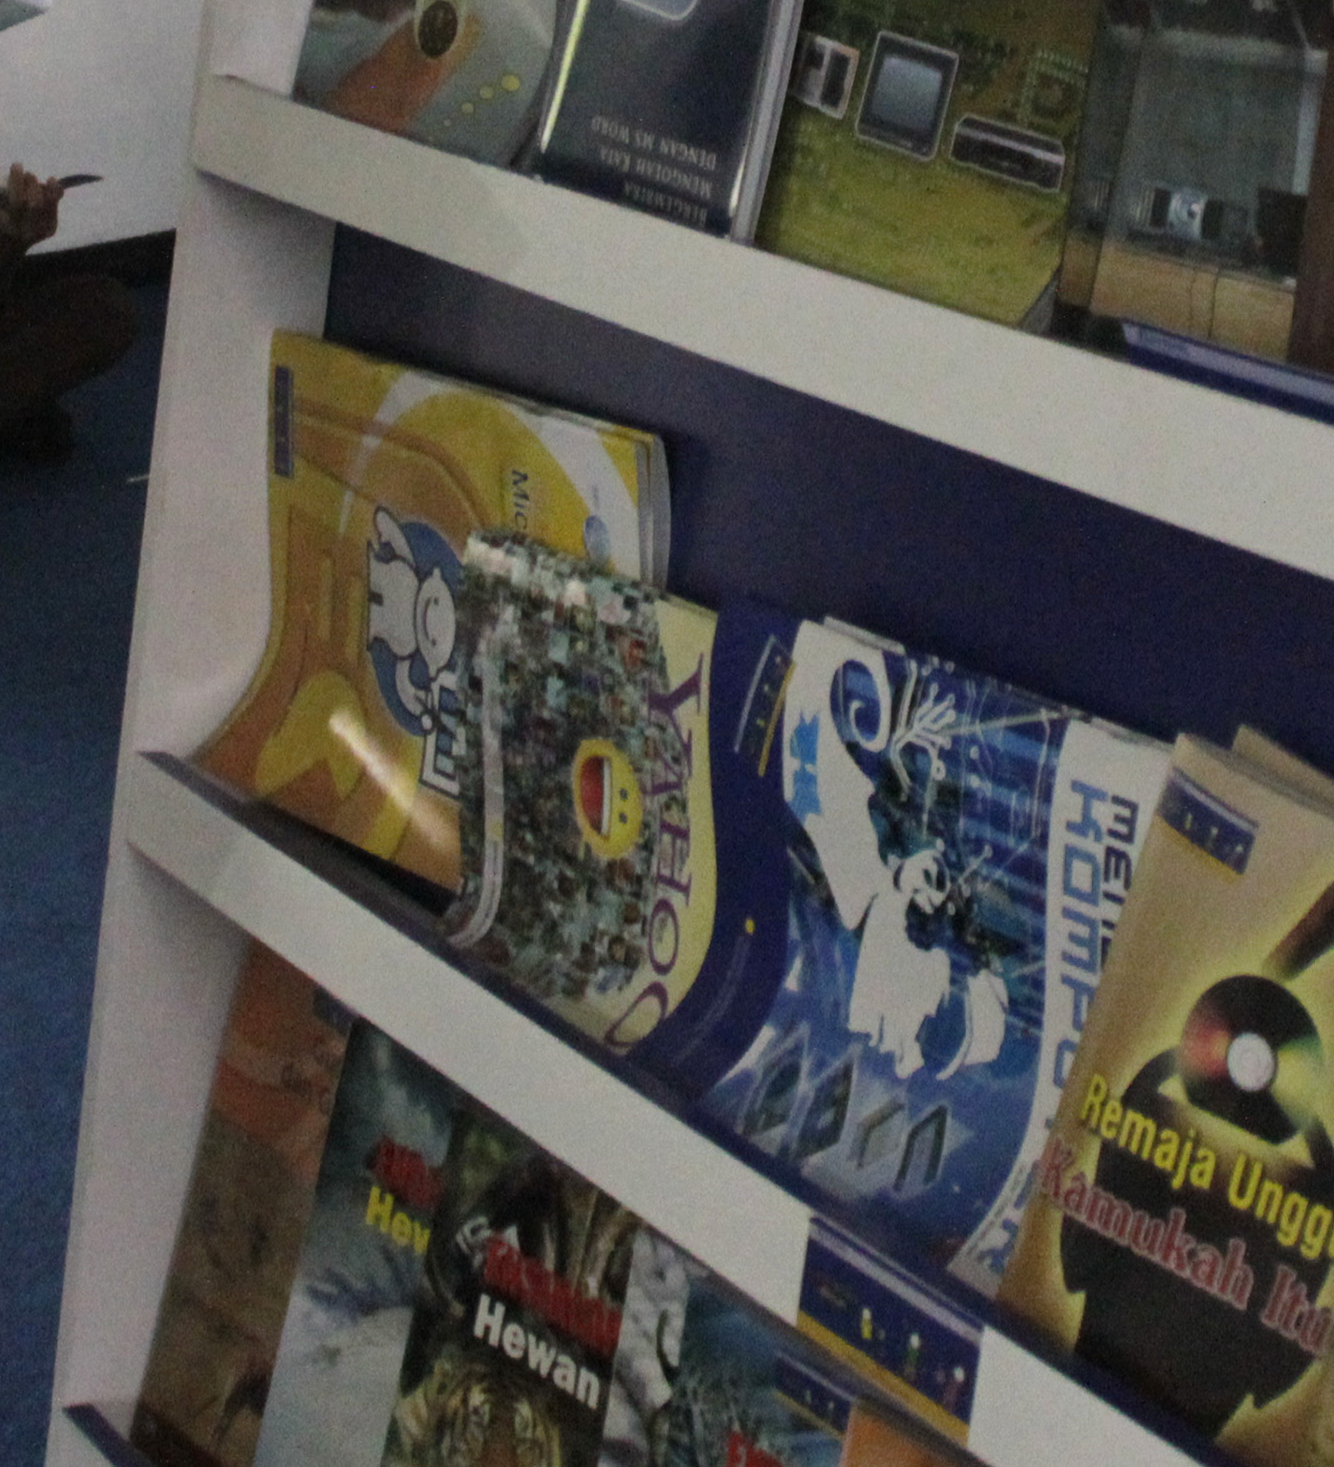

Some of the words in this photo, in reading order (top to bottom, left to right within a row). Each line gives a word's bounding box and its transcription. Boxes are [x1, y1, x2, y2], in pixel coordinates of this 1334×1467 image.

[1079, 1072, 1217, 1193] Remaja
[1038, 1138, 1256, 1312] Kamukah
[473, 1292, 601, 1410] Hewan
